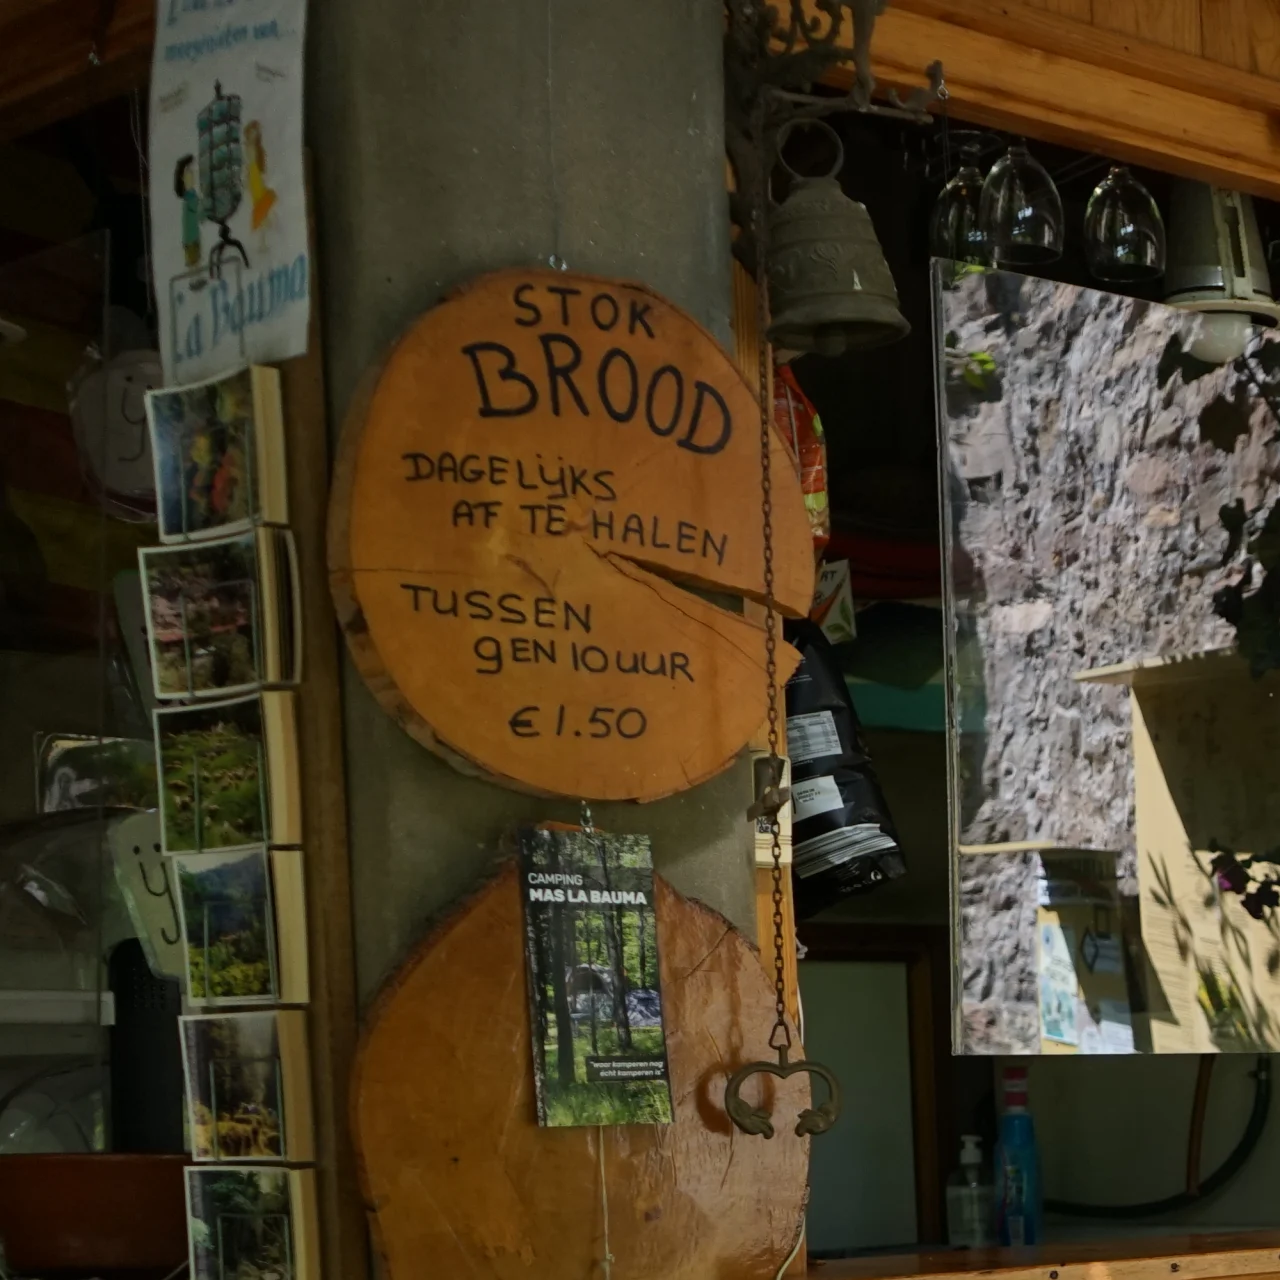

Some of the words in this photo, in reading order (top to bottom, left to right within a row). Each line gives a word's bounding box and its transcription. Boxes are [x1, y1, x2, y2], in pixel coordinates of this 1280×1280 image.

[514, 284, 656, 339] STOK
[462, 334, 733, 455] BROOD
[452, 500, 503, 528] AF
[520, 505, 569, 537] TE
[592, 511, 729, 566] HALEN
[401, 583, 592, 633] TUSSEN
[474, 637, 502, 674] 9
[512, 639, 557, 665] EN
[528, 872, 584, 887] CAMPING
[529, 888, 565, 903] MAS
[567, 889, 588, 904] LA
[590, 889, 648, 905] BAUMA
